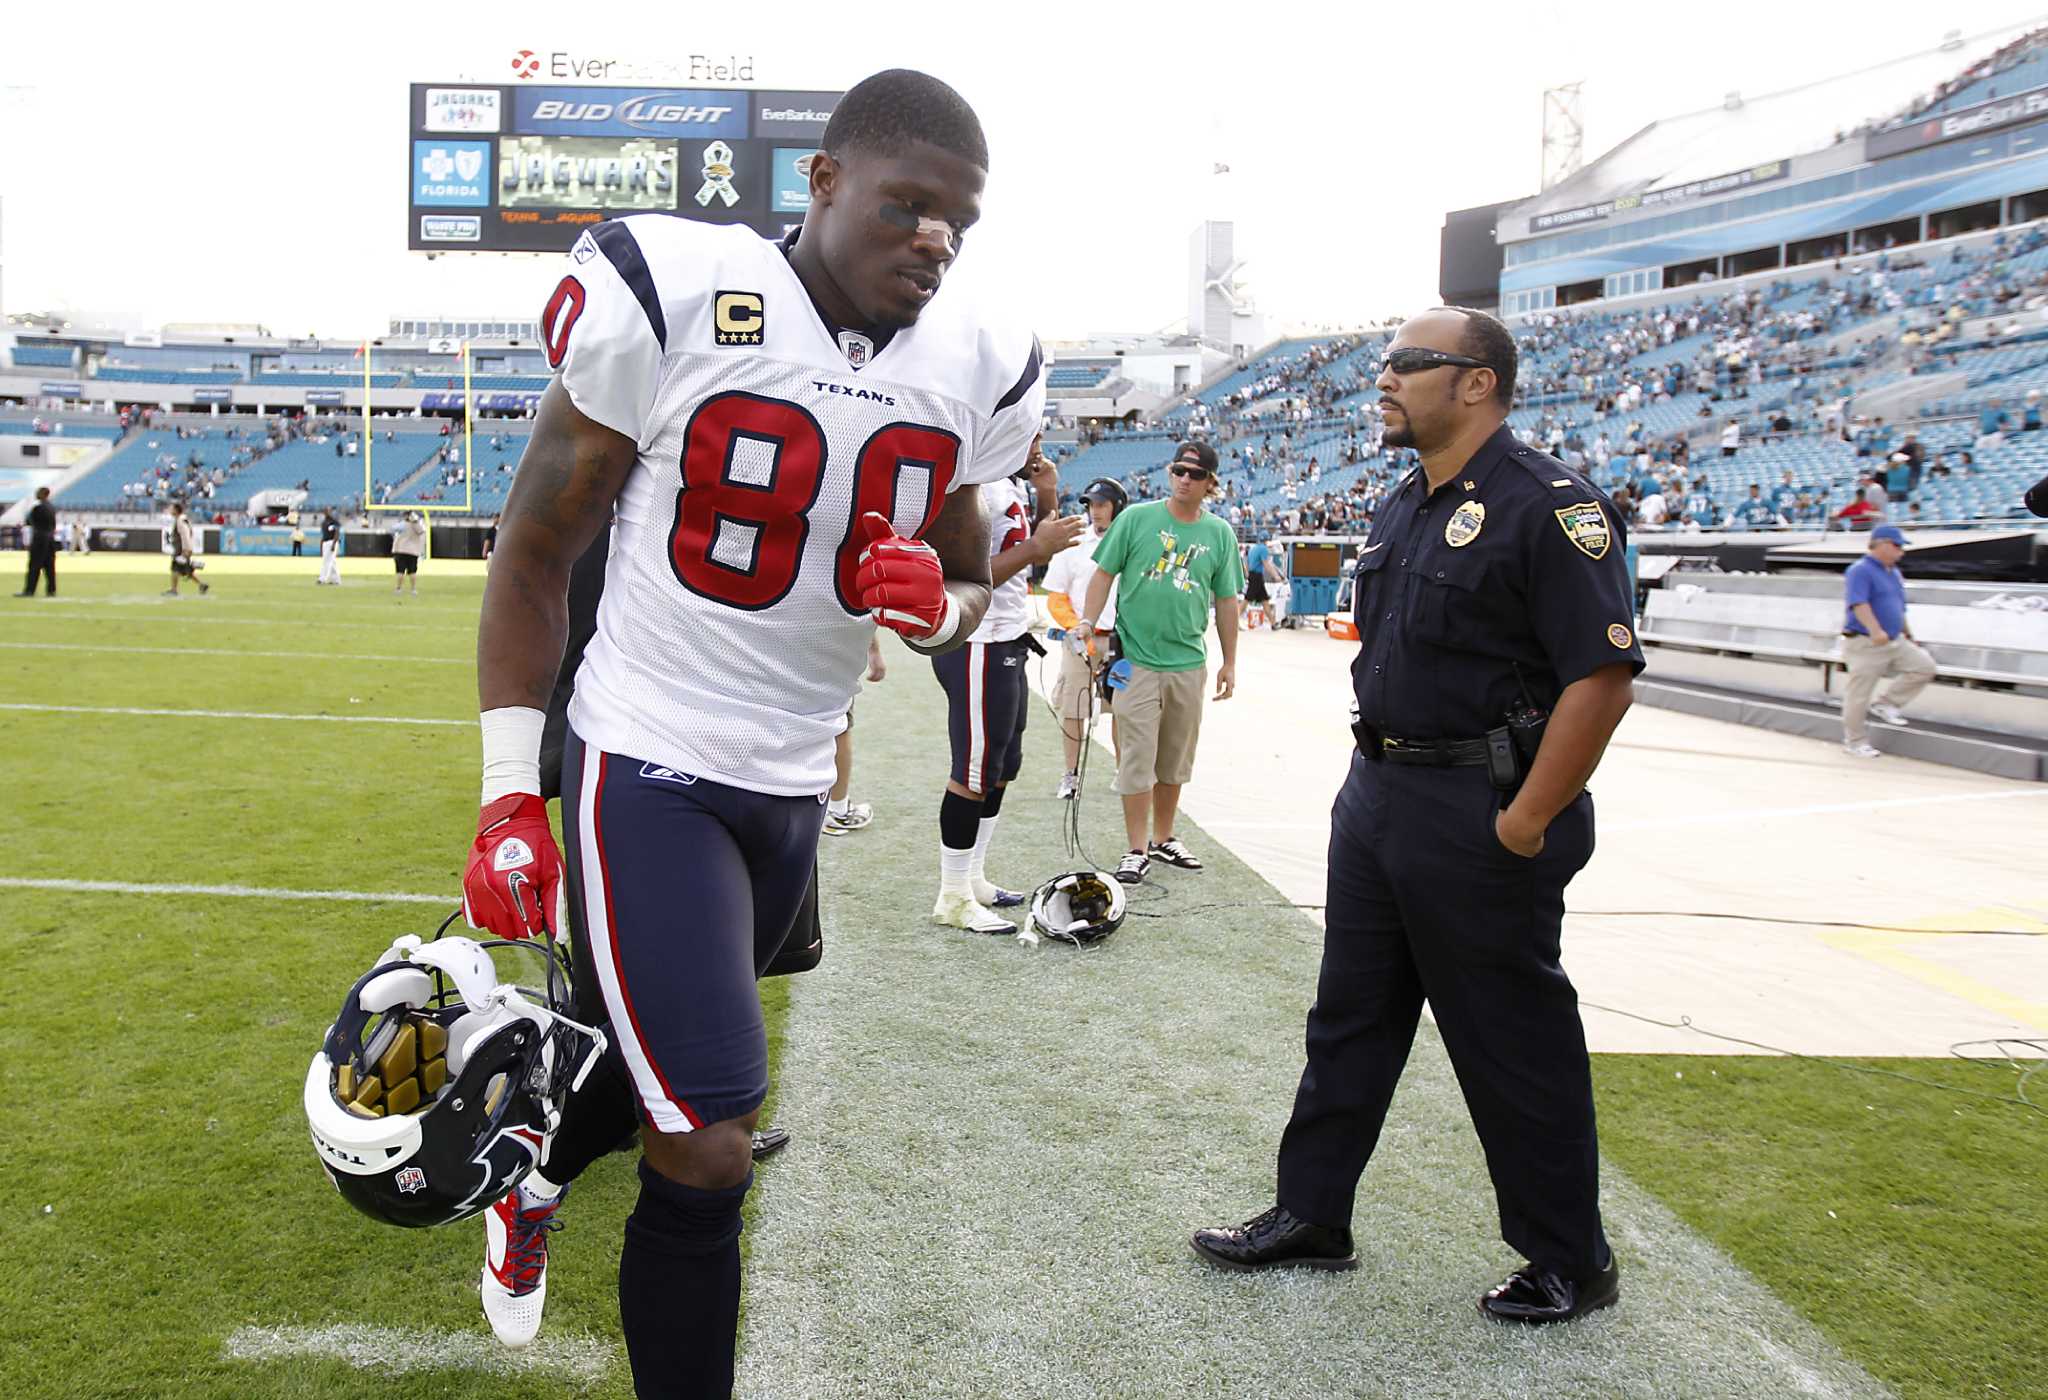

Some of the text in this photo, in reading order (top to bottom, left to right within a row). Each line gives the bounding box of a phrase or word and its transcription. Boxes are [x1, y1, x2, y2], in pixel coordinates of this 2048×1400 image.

[689, 55, 754, 81] Field
[432, 93, 495, 108] JAGUARS
[532, 100, 732, 123] BUD LIGHT
[503, 150, 673, 191] JAGUARS
[421, 184, 480, 197] FLORIDA
[716, 294, 762, 332] C
[812, 381, 896, 406] TEXANS
[668, 390, 962, 616] 80
[399, 1170, 422, 1185] NFL
